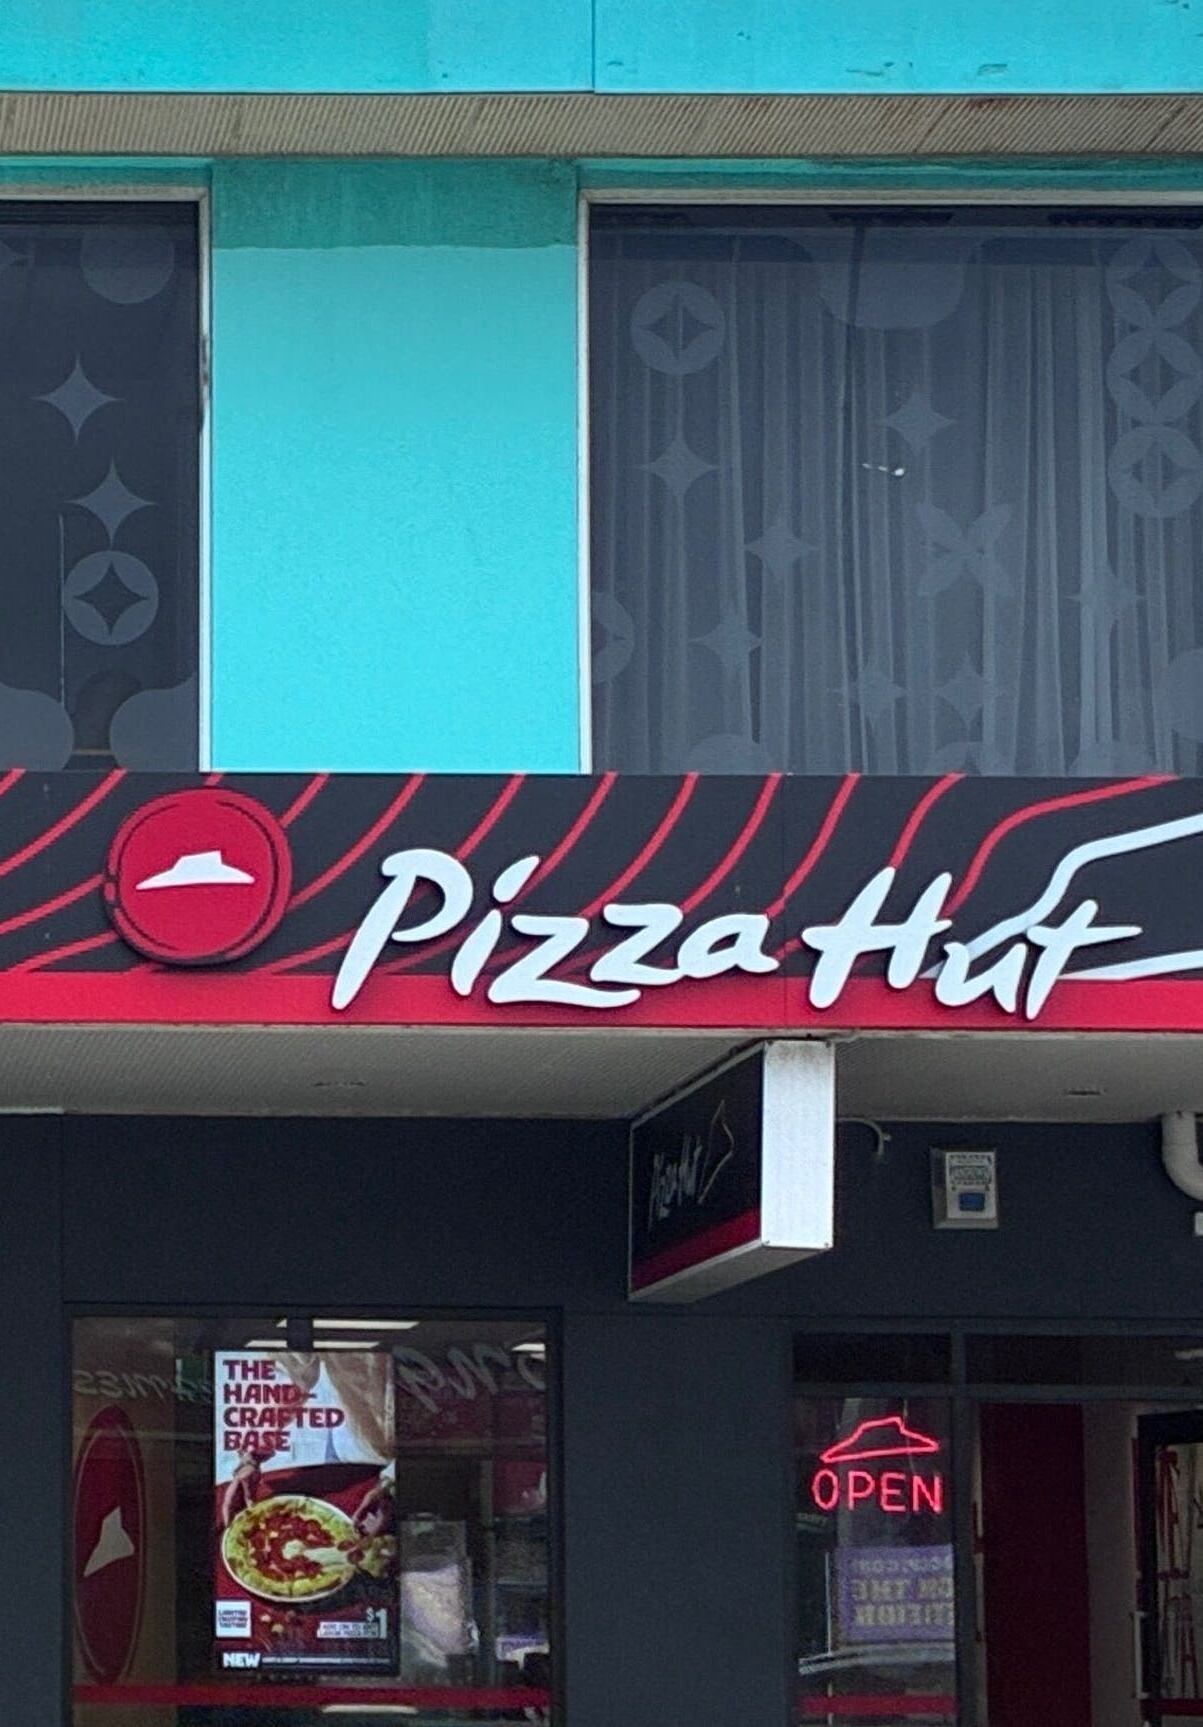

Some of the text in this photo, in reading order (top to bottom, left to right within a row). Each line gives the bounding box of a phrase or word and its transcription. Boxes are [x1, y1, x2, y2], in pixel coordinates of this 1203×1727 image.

[331, 847, 1143, 1020] Pizza Hut
[222, 1359, 276, 1381] THE
[223, 1383, 317, 1405] HAND-
[223, 1406, 345, 1429] CRAFTED
[223, 1430, 292, 1452] BASE
[811, 1469, 944, 1514] OPEN
[223, 1652, 261, 1669] NEW
